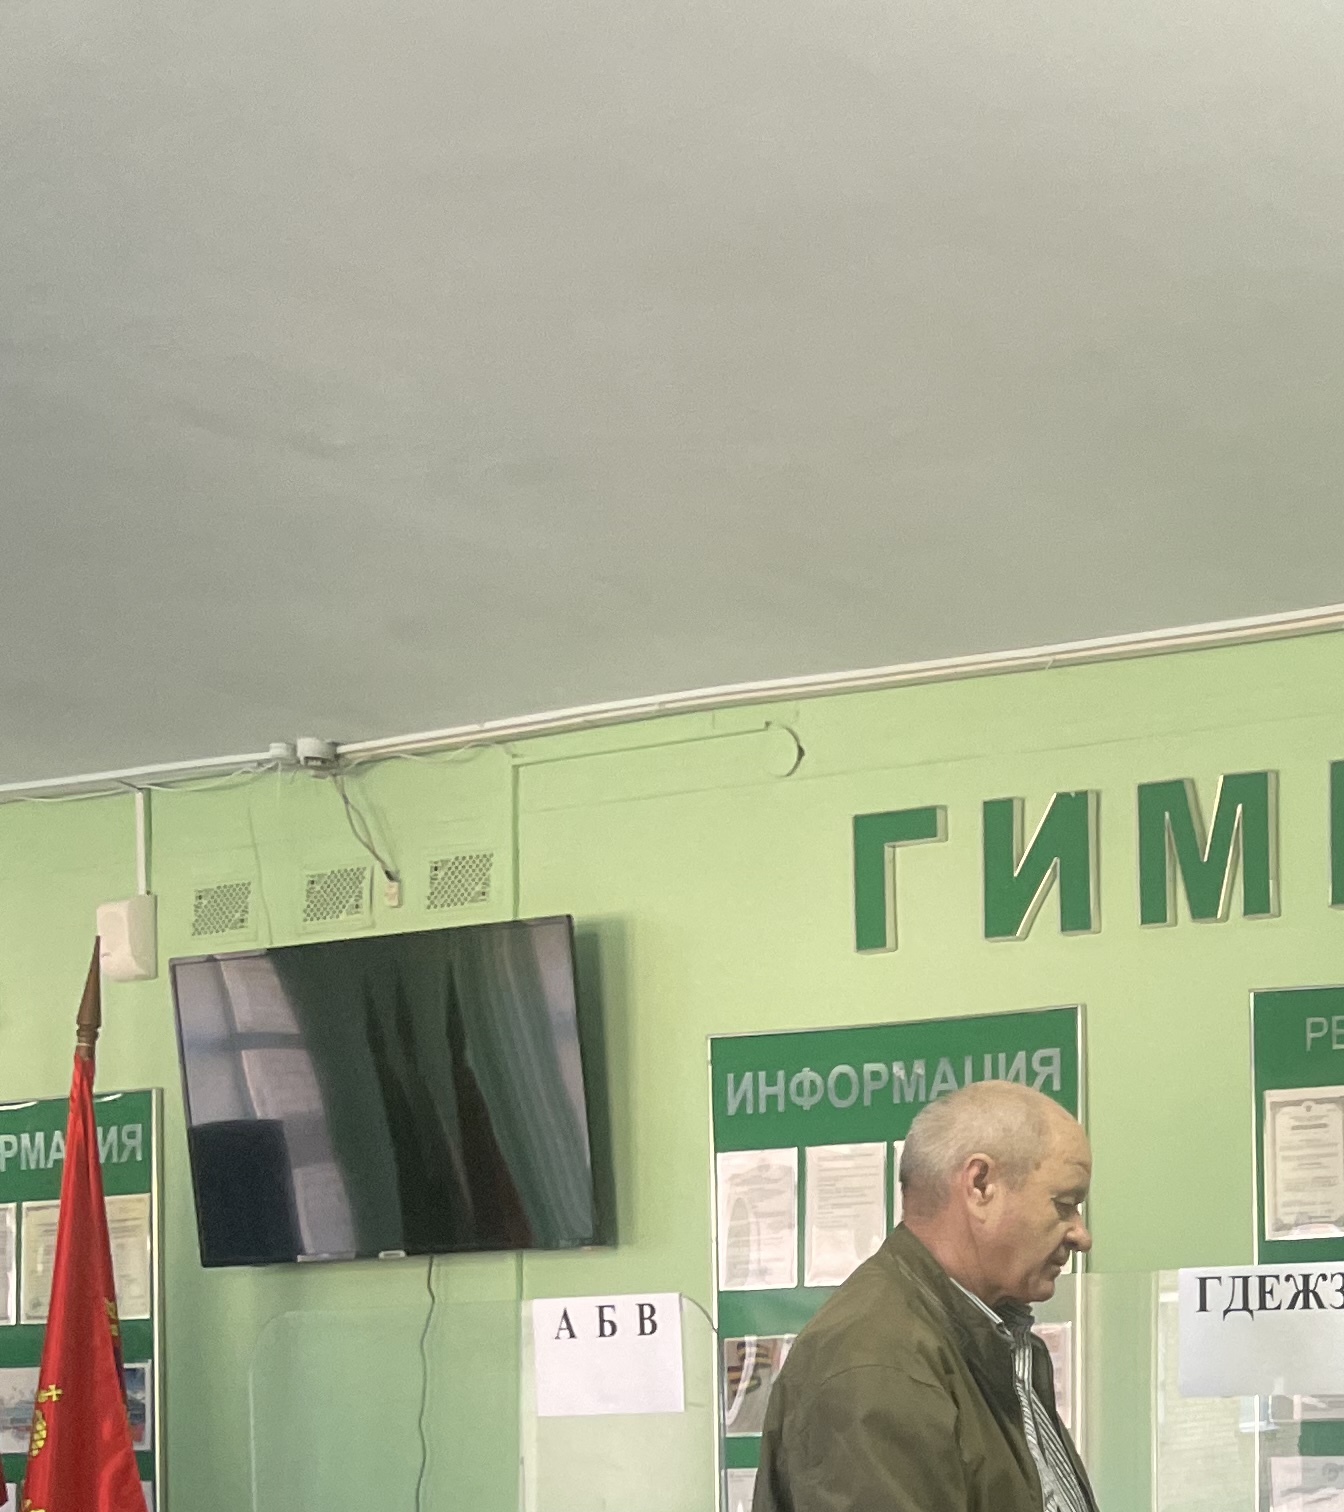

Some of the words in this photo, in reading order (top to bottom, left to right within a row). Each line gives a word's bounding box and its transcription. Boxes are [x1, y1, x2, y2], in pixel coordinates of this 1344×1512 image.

[0, 1123, 143, 1173] РМАИЯ
[554, 1306, 577, 1339] А
[595, 1304, 618, 1338] Б
[635, 1302, 658, 1336] В
